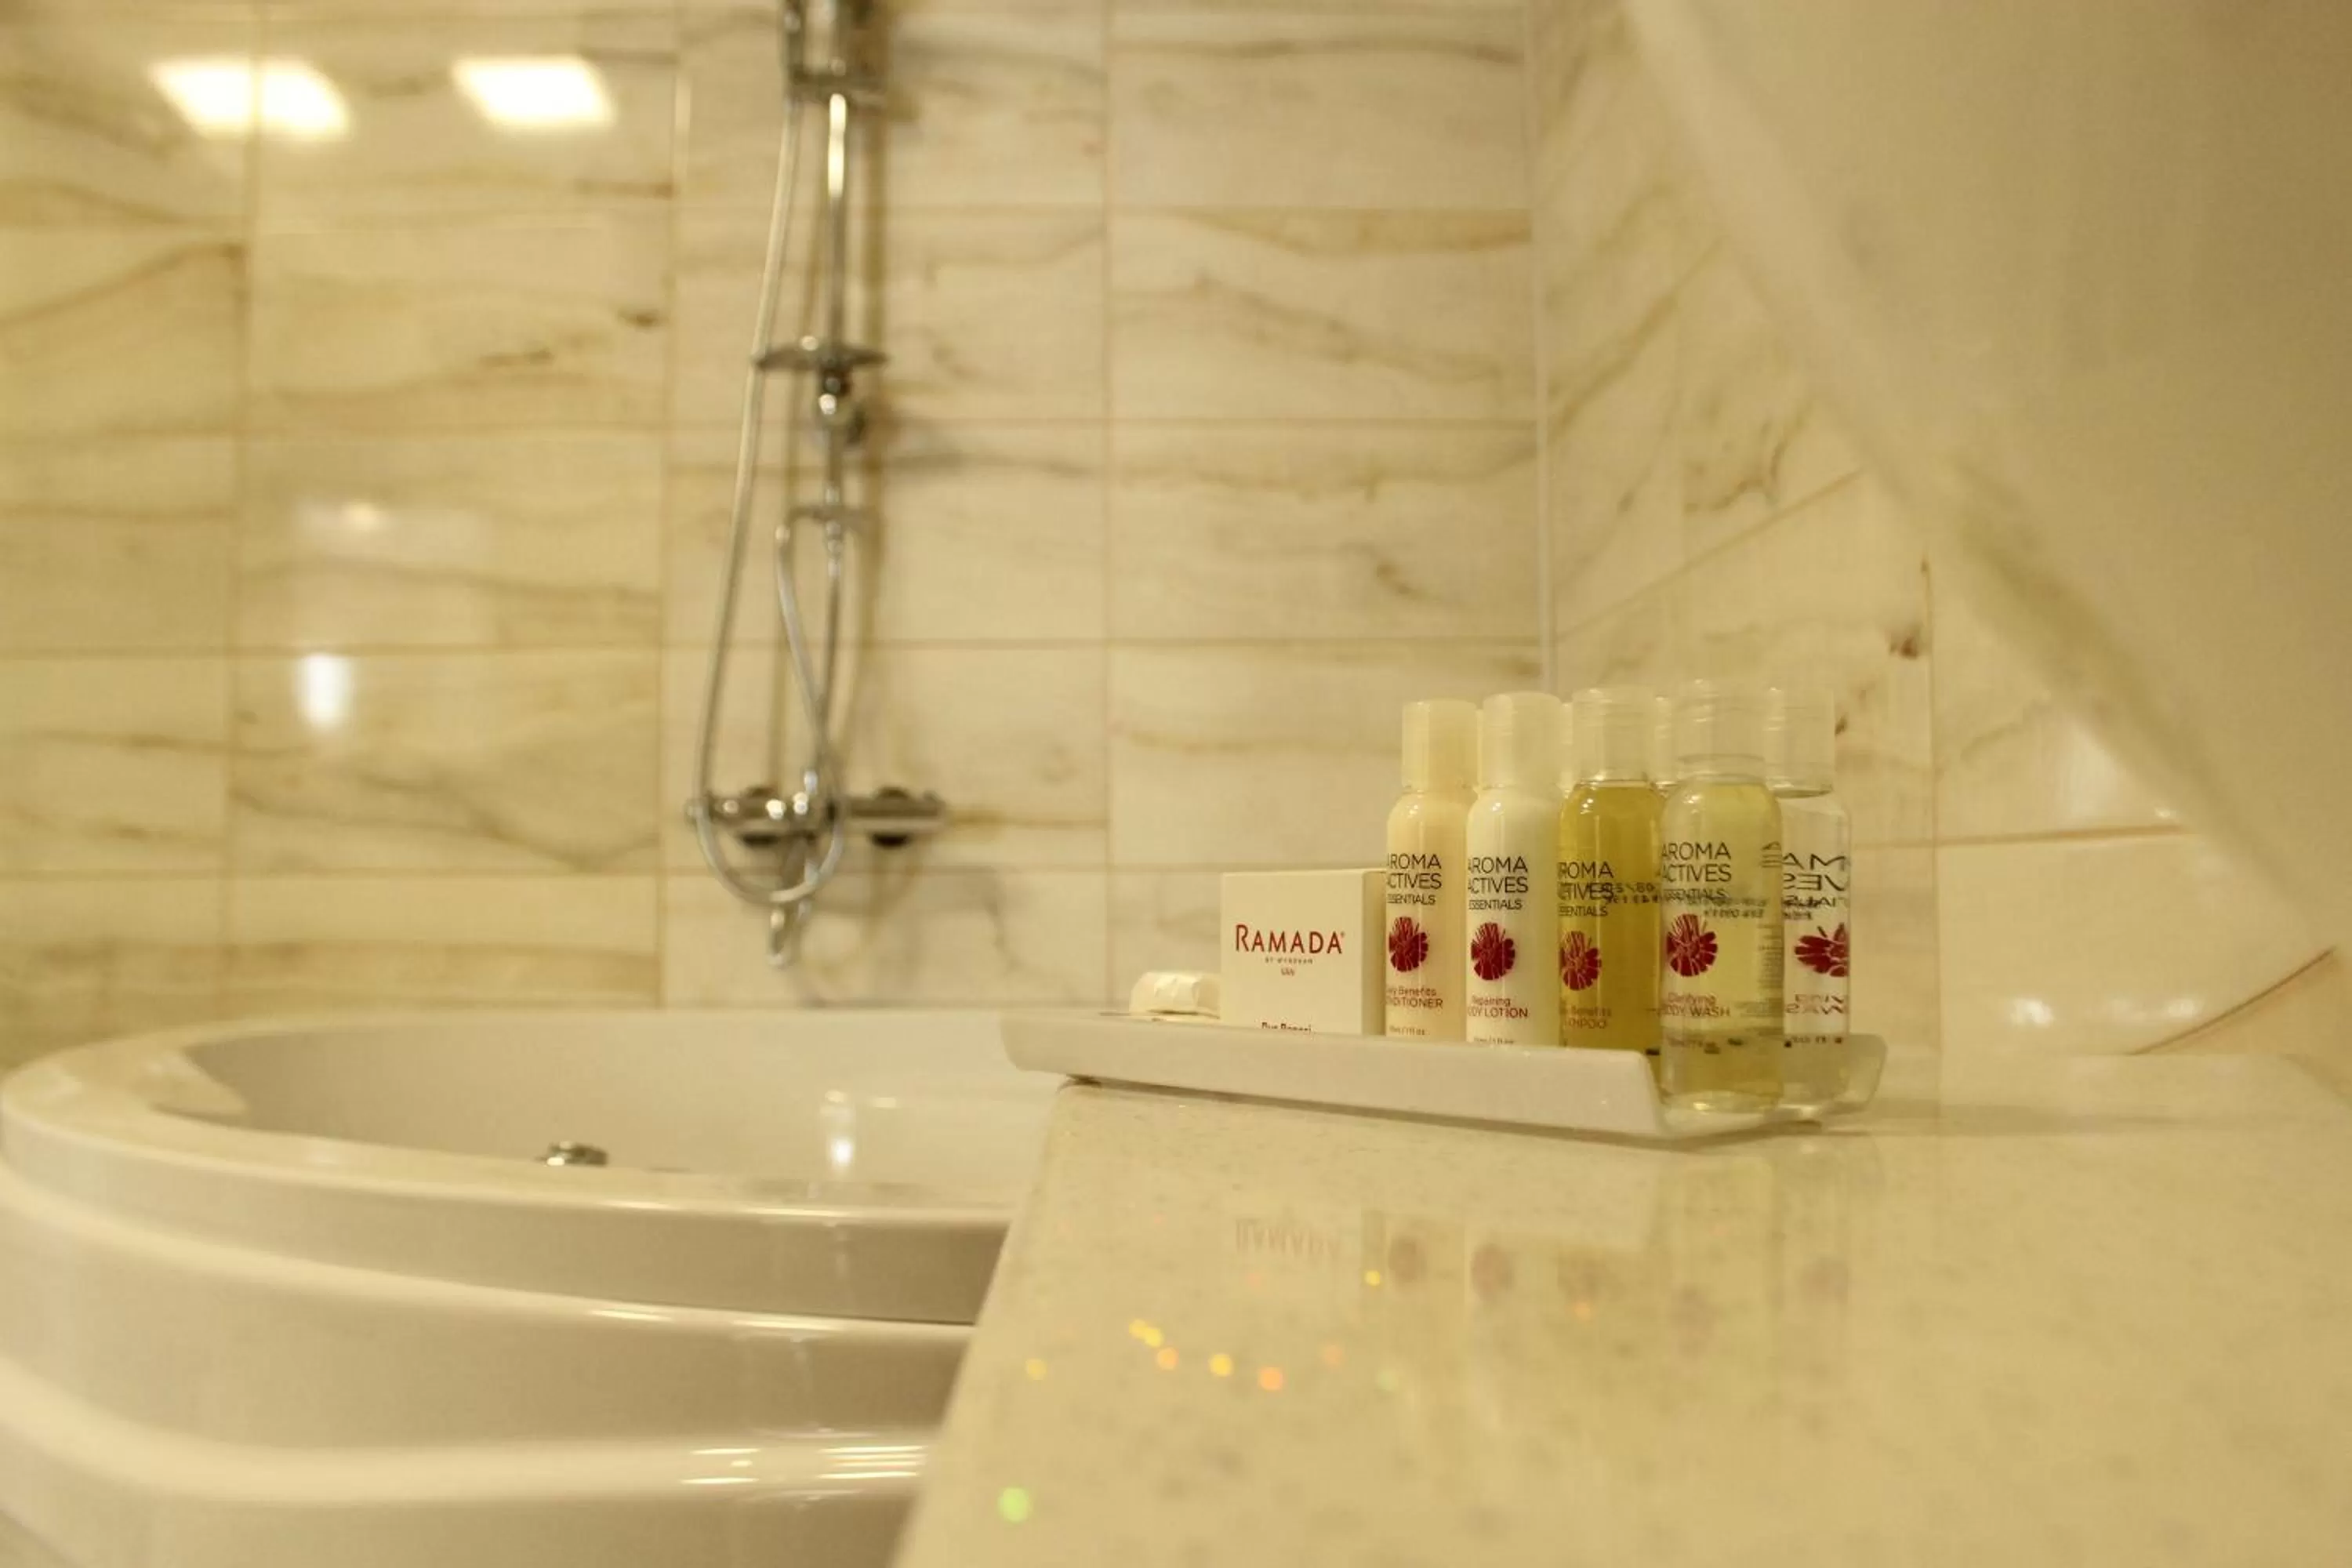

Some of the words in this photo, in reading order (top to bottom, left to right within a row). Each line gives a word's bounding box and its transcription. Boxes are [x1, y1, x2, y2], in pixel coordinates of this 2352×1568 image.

[1387, 853, 1442, 869] ROMA
[1558, 861, 1614, 879] ROMA
[1387, 873, 1442, 889] CTIVES
[1557, 882, 1614, 900] CTIVES
[1236, 924, 1343, 954] RAMADA
[1484, 1007, 1528, 1018] LOTION
